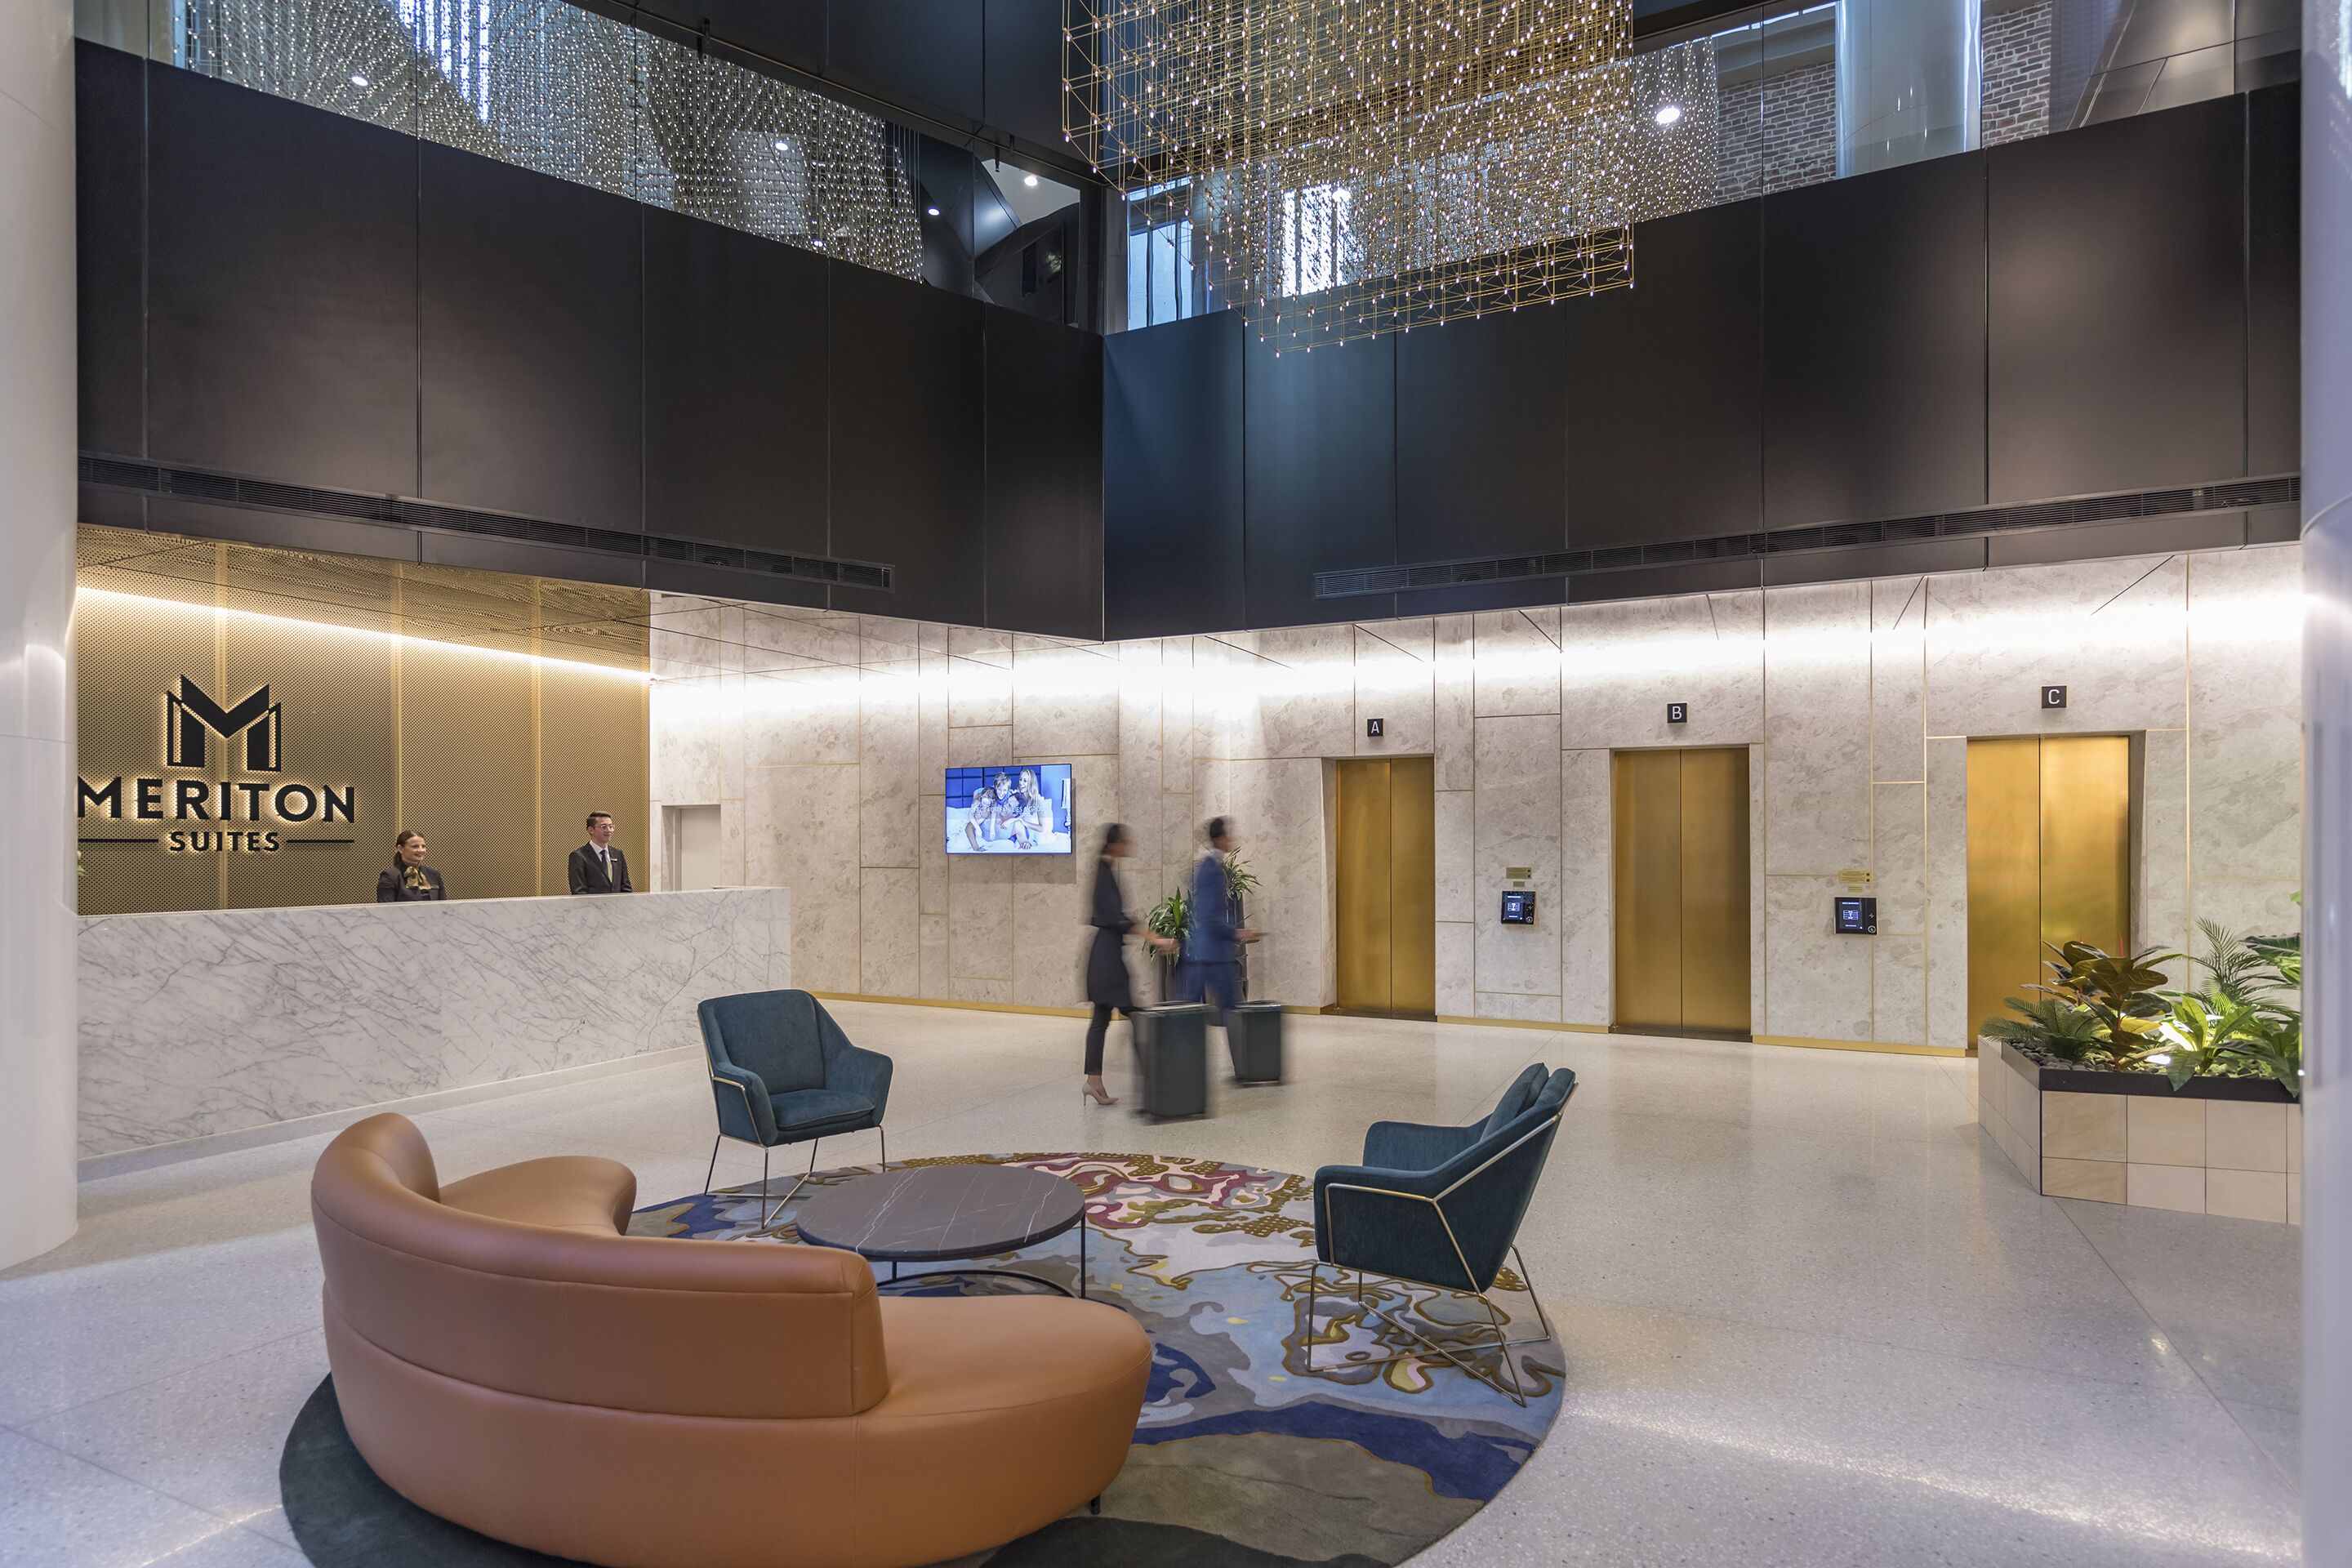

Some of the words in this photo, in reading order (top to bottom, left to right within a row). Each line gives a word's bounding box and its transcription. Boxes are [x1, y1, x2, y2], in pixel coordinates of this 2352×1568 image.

[2048, 689, 2060, 705] C
[1673, 706, 1682, 719] B
[1370, 721, 1380, 733] A
[78, 775, 355, 823] MERITON
[170, 831, 280, 852] SUITES
